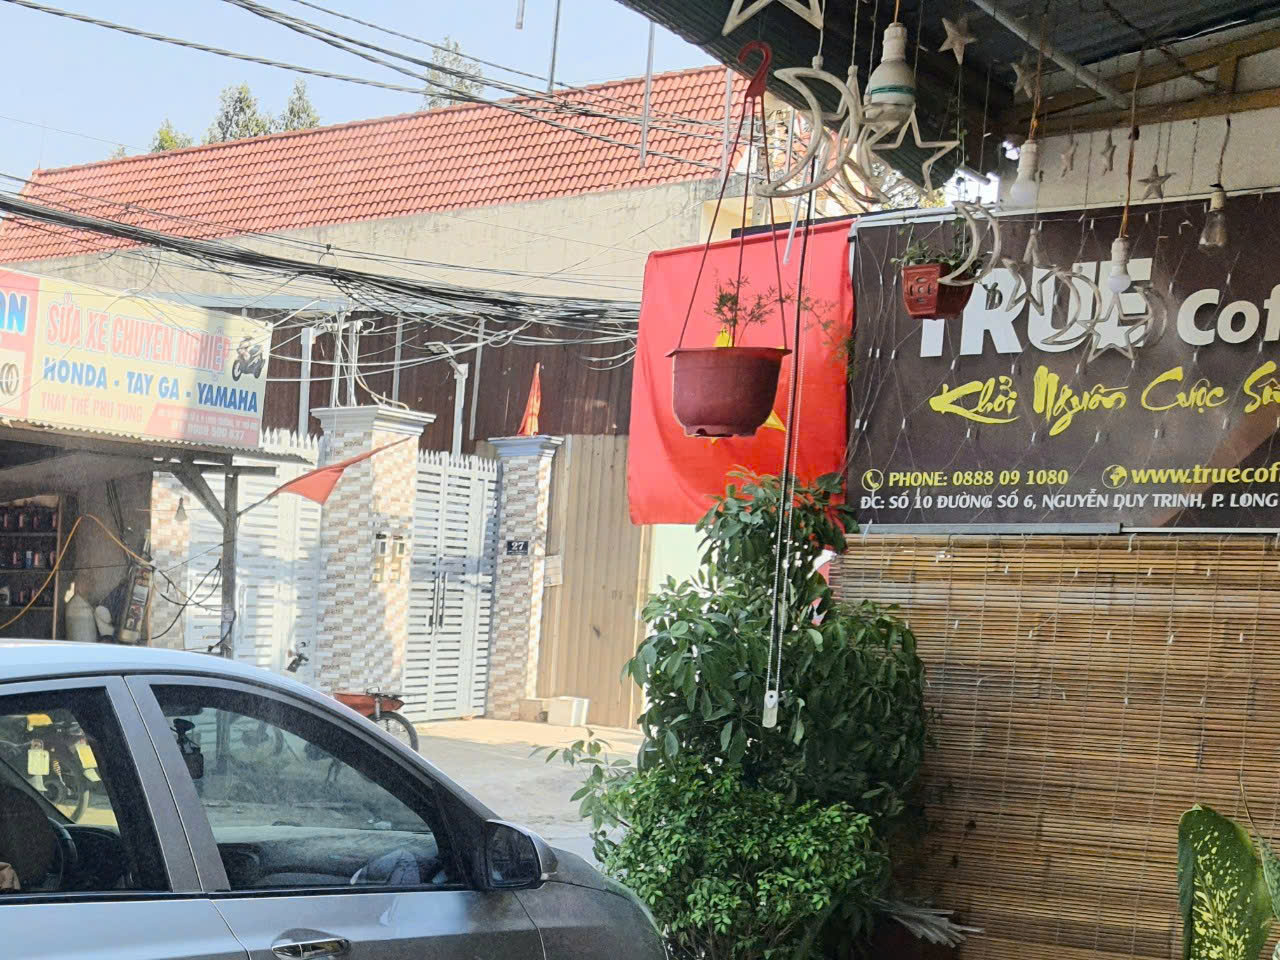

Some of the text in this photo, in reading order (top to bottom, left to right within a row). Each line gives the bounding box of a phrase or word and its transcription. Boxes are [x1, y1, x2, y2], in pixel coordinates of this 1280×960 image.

[85, 308, 110, 352] XE
[43, 356, 258, 413] HONDA TAY GA YAMAHA
[888, 471, 948, 487] PHONE:
[952, 470, 994, 486] 0888
[999, 470, 1021, 486] 09
[1025, 469, 1069, 486] 1080
[860, 488, 1279, 510] ĐC: SỐ 10 ĐƯỜNG SỐ 6, NGUYỄN DUY TRINH, P. LONG
[511, 541, 524, 550] 27
